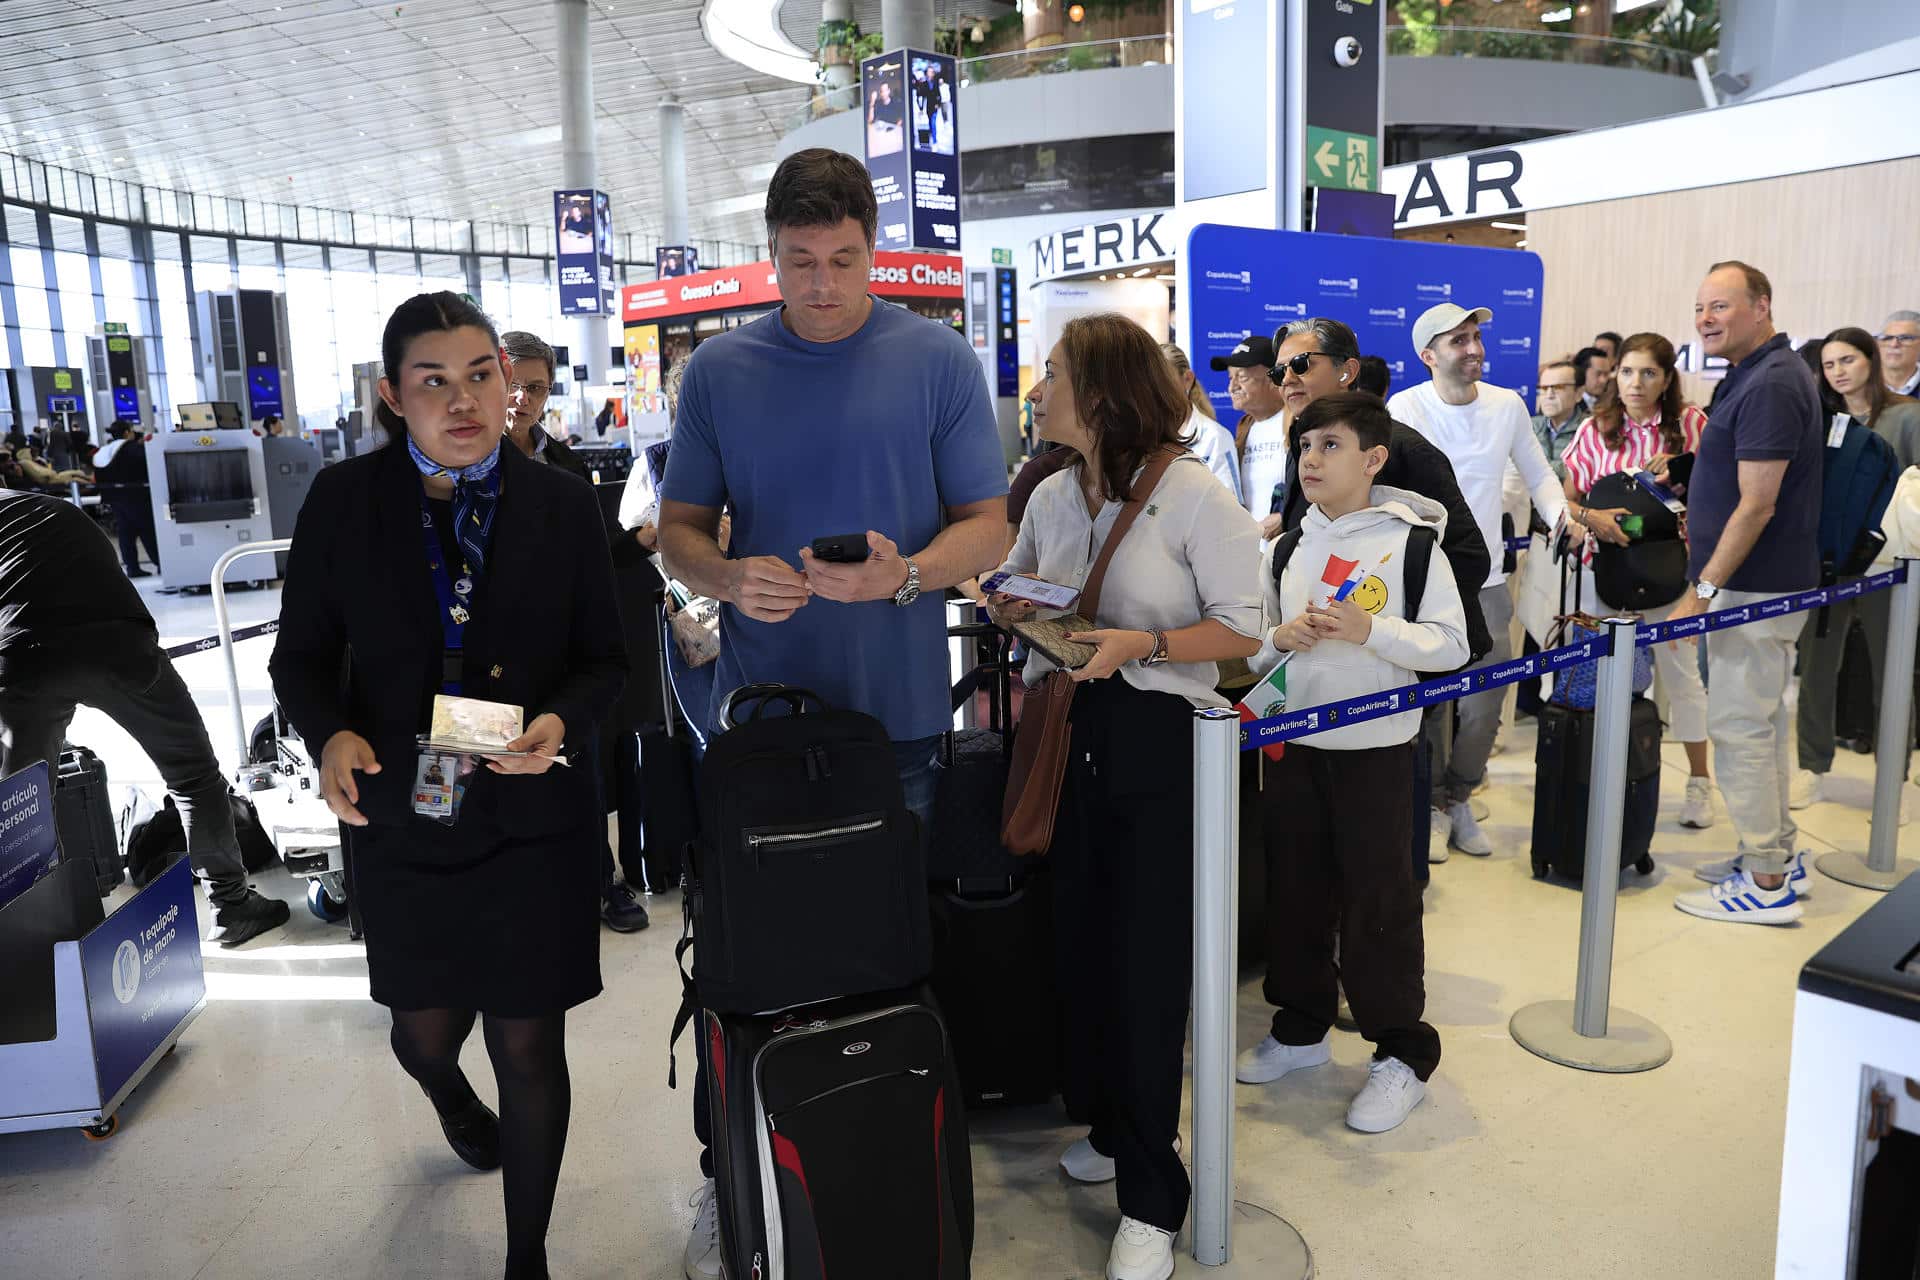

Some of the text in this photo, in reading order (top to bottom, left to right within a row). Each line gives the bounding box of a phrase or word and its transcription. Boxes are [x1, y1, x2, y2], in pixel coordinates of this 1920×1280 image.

[1035, 214, 1175, 277] MERK
[911, 263, 962, 286] Chela
[1206, 270, 1242, 280] CopaAirlines
[1673, 622, 1699, 633] CopaAirlines
[1553, 649, 1583, 663] CopaAirlines
[1492, 665, 1526, 680] CopaAirlines
[1424, 681, 1462, 698] CopaAirlines
[1347, 699, 1389, 716] CopaAirlines
[1260, 718, 1307, 737] CopaAirlines
[0, 798, 39, 838] personal
[140, 904, 178, 946] 1 equipaje
[143, 927, 176, 965] de mano
